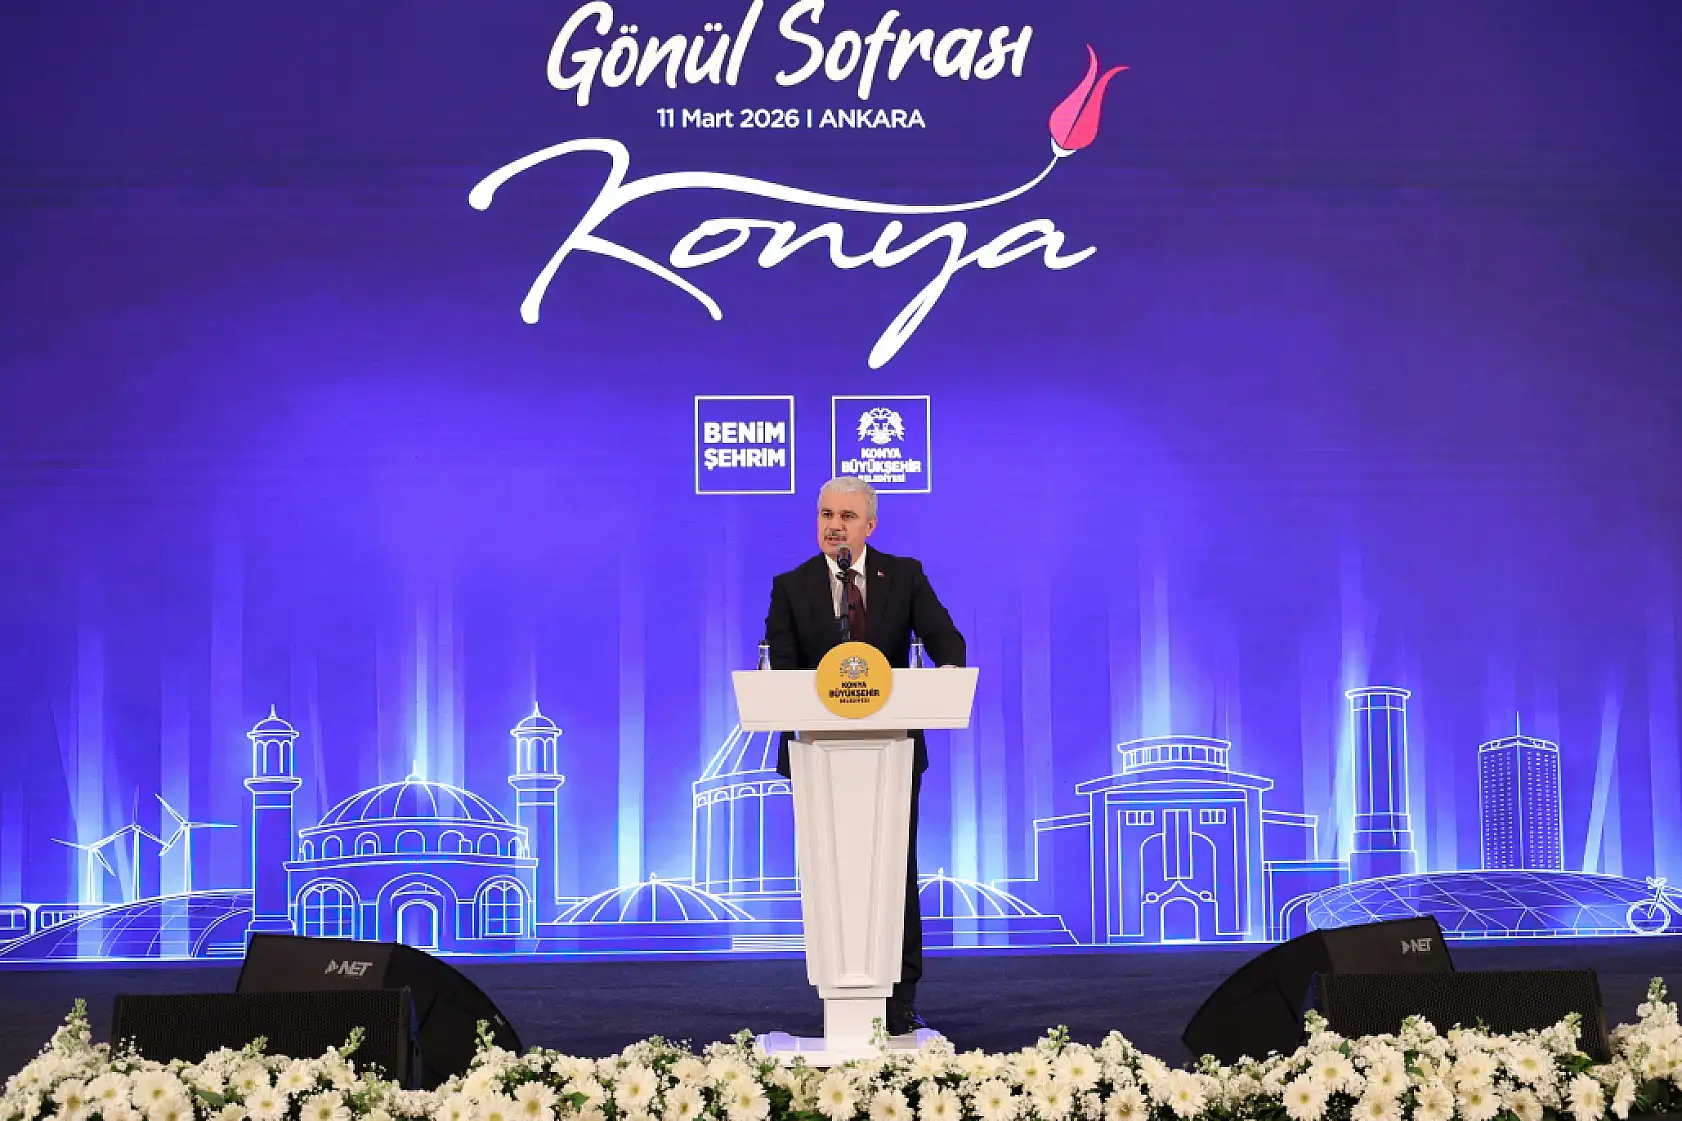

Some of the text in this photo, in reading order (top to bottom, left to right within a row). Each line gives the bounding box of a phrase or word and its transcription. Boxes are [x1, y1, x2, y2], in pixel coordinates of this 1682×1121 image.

[546, 0, 1033, 106] Gönül Sofrası
[656, 108, 675, 128] 11
[682, 108, 735, 128] Mart
[739, 108, 800, 128] 2026
[818, 108, 926, 128] ANKARA
[468, 137, 1098, 370] Konya
[860, 447, 902, 459] KONYA
[1410, 937, 1433, 952] NET
[337, 960, 373, 975] NET
